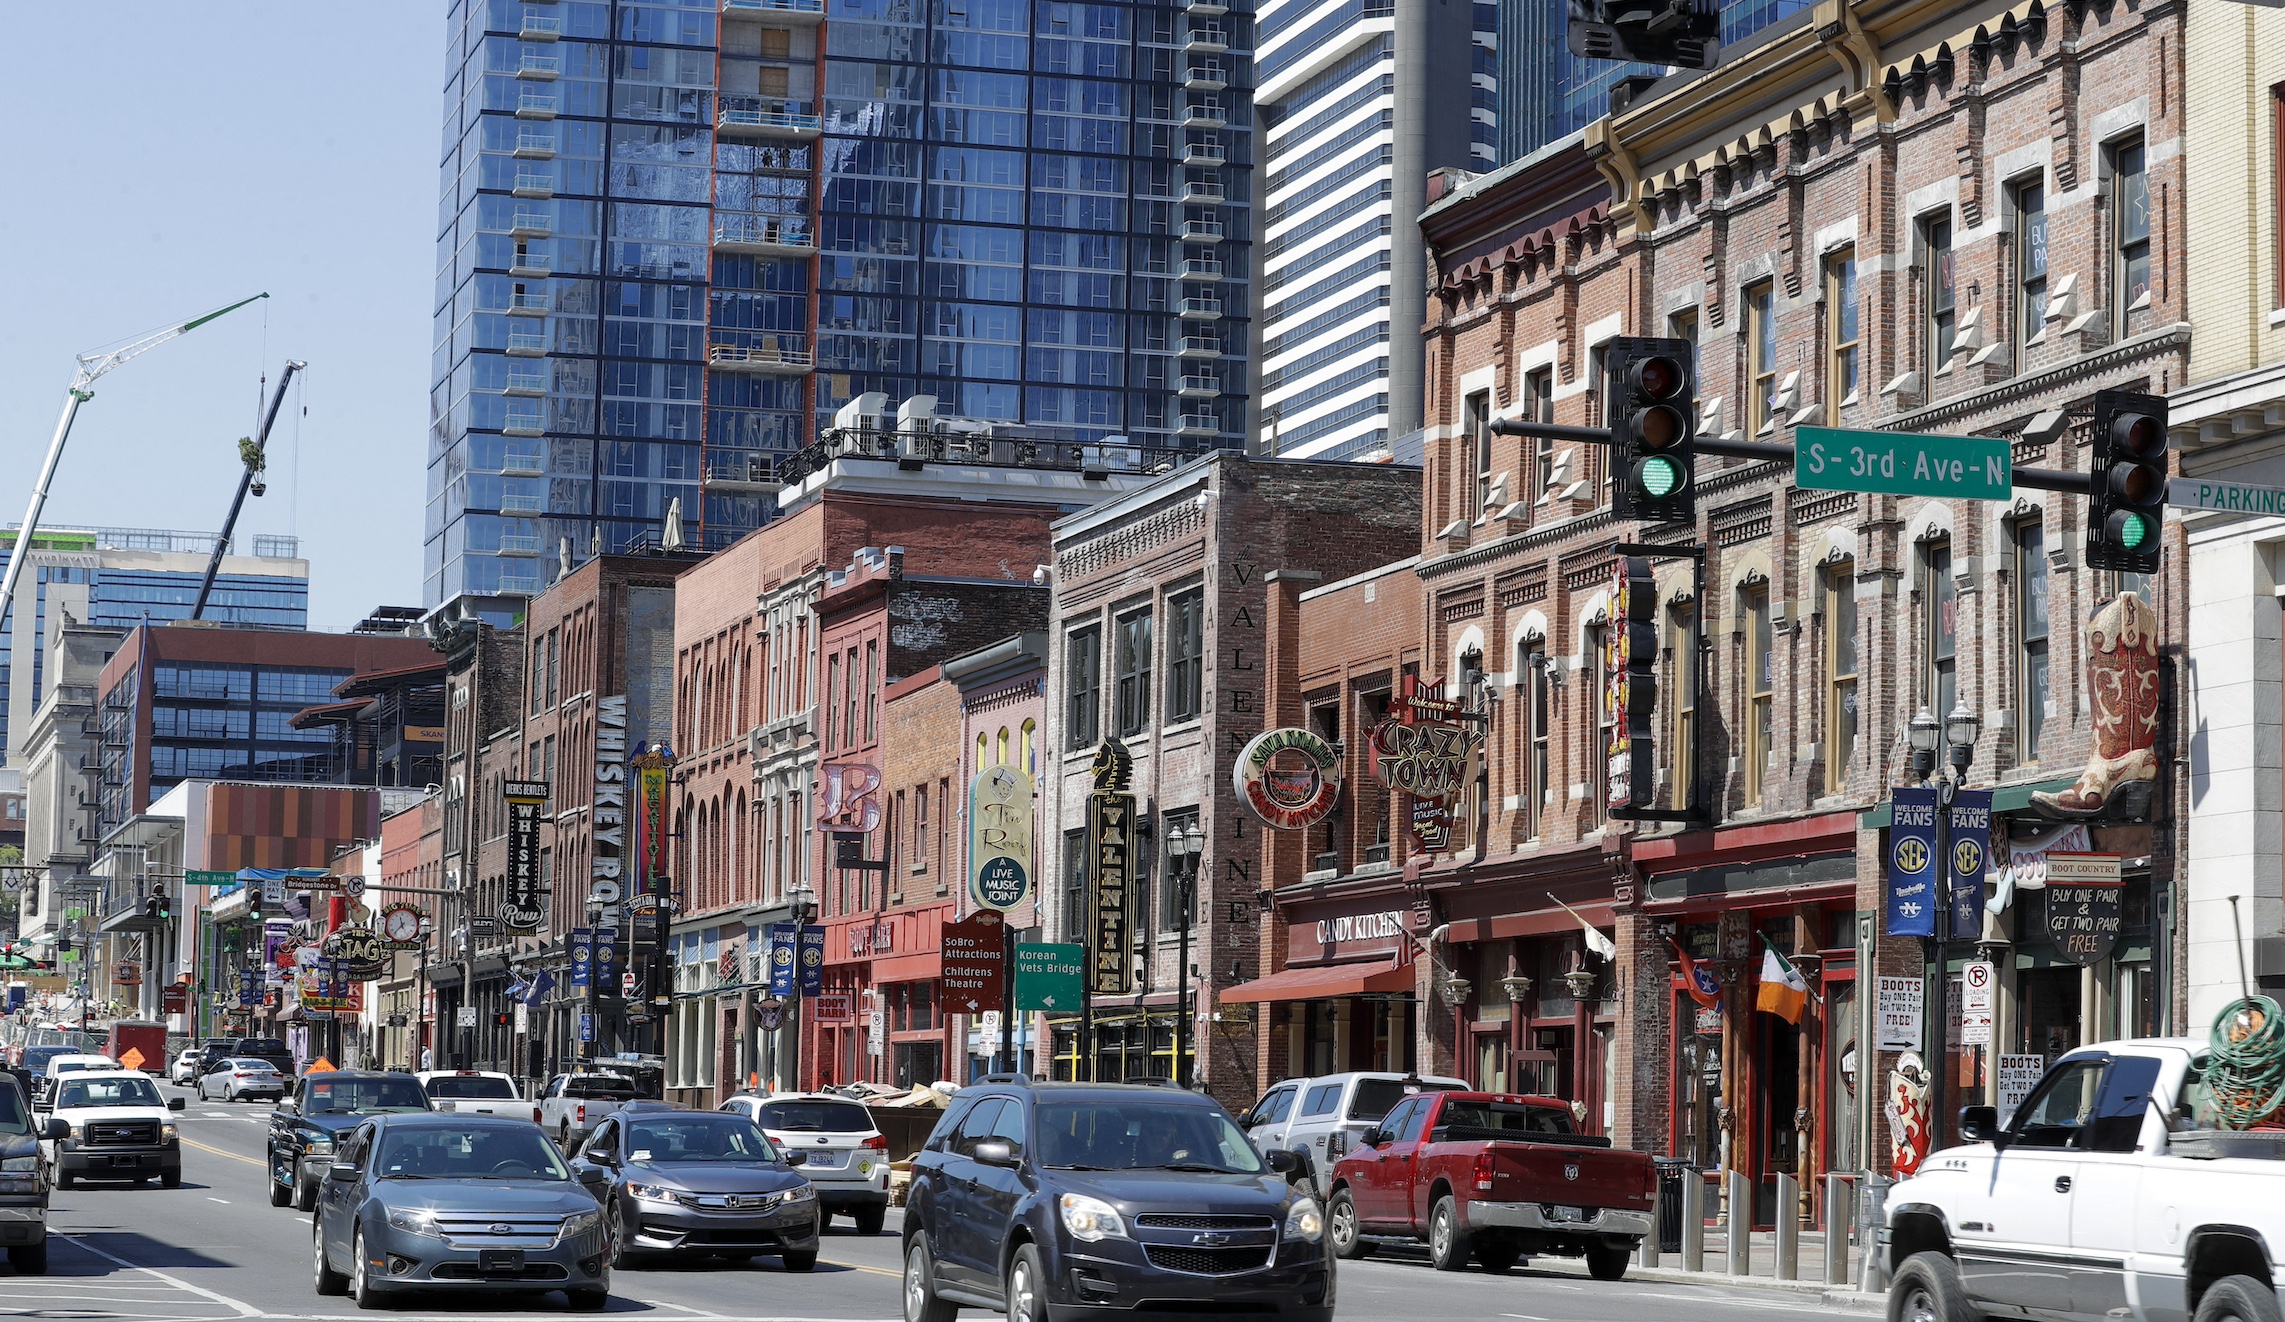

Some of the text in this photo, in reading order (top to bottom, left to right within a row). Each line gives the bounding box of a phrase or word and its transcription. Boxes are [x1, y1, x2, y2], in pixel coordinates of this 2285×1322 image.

[2200, 484, 2285, 514] PARKING
[25, 554, 57, 562] GRAND
[1408, 696, 1456, 712] Welcome to
[1201, 564, 1215, 923] VALENTINE
[1226, 564, 1257, 923] VALENINE
[1374, 718, 1484, 758] CRAZY
[594, 694, 627, 847] WHISKEY
[1377, 757, 1468, 791] TOWN
[505, 783, 522, 795] DIERKS
[1104, 796, 1122, 804] the
[1247, 780, 1285, 824] CANDY
[1287, 782, 1337, 827] KITCHEN
[984, 804, 1022, 826] Tin
[1951, 807, 1989, 816] WELCOME
[1894, 812, 1933, 826] FANS
[1952, 815, 1988, 829] FANS
[645, 774, 662, 890] MARGARITAVILLE
[1419, 826, 1439, 838] Food
[979, 828, 1028, 856] Roof
[517, 805, 534, 905] WHISKEY
[1898, 841, 1926, 871] SEC
[1957, 842, 1979, 873] SEC
[1000, 859, 1007, 867] A
[2051, 864, 2117, 874] BOOT COUNTRY
[992, 869, 1013, 879] LIVE
[287, 880, 329, 890] Bridgestone
[986, 880, 1020, 891] MUSIC
[986, 891, 1018, 901] JOINT
[1099, 807, 1124, 992] VALENTINE
[2051, 889, 2119, 904] BUY ONE PAIR
[384, 903, 397, 914] BIG
[628, 895, 657, 910] RESTAURA
[503, 903, 539, 926] Row
[2078, 903, 2089, 915] &
[1316, 910, 1404, 944] CANDY KITCHEN
[2050, 916, 2120, 932] GET TWO PAIR
[849, 926, 870, 952] BOOT
[945, 938, 975, 947] SoBro
[2067, 934, 2099, 953] FREE
[774, 948, 792, 965] SEC
[804, 950, 820, 965] SEC
[945, 949, 1001, 960] Attractions
[1019, 951, 1057, 960] Korean
[944, 967, 993, 977] Childrens
[1020, 963, 1082, 976] Vets Bridge
[944, 978, 984, 989] Theatre
[1881, 980, 1921, 992] BOOTS
[1880, 992, 1921, 1002] Buy ONE Pair
[1966, 988, 1989, 996] LOADING
[817, 998, 846, 1008] BOOT
[1880, 1003, 1921, 1012] Get TWO Pair
[817, 1008, 846, 1018] BARN
[1886, 1014, 1914, 1026] FREE!
[2001, 1057, 2040, 1069] BOOTS
[2000, 1070, 2041, 1080] Buy ONE Pair
[2000, 1081, 2010, 1090] Get
[2011, 1081, 2027, 1090] TWO
